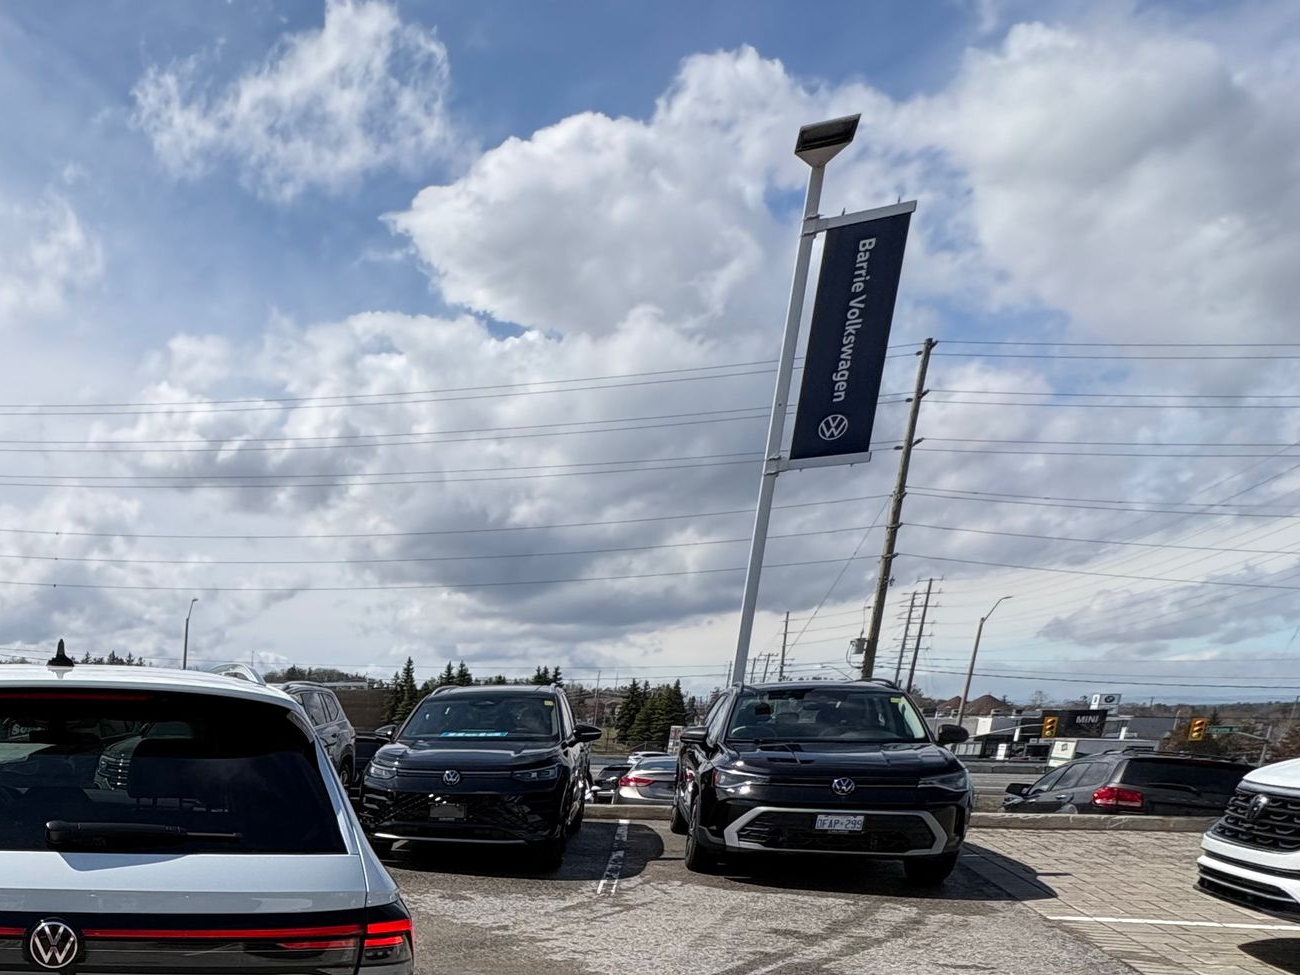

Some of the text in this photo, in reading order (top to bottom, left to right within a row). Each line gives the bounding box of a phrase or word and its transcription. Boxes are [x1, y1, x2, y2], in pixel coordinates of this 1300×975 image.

[831, 237, 876, 402] Barrie Volkswagen
[1075, 715, 1099, 724] MINI
